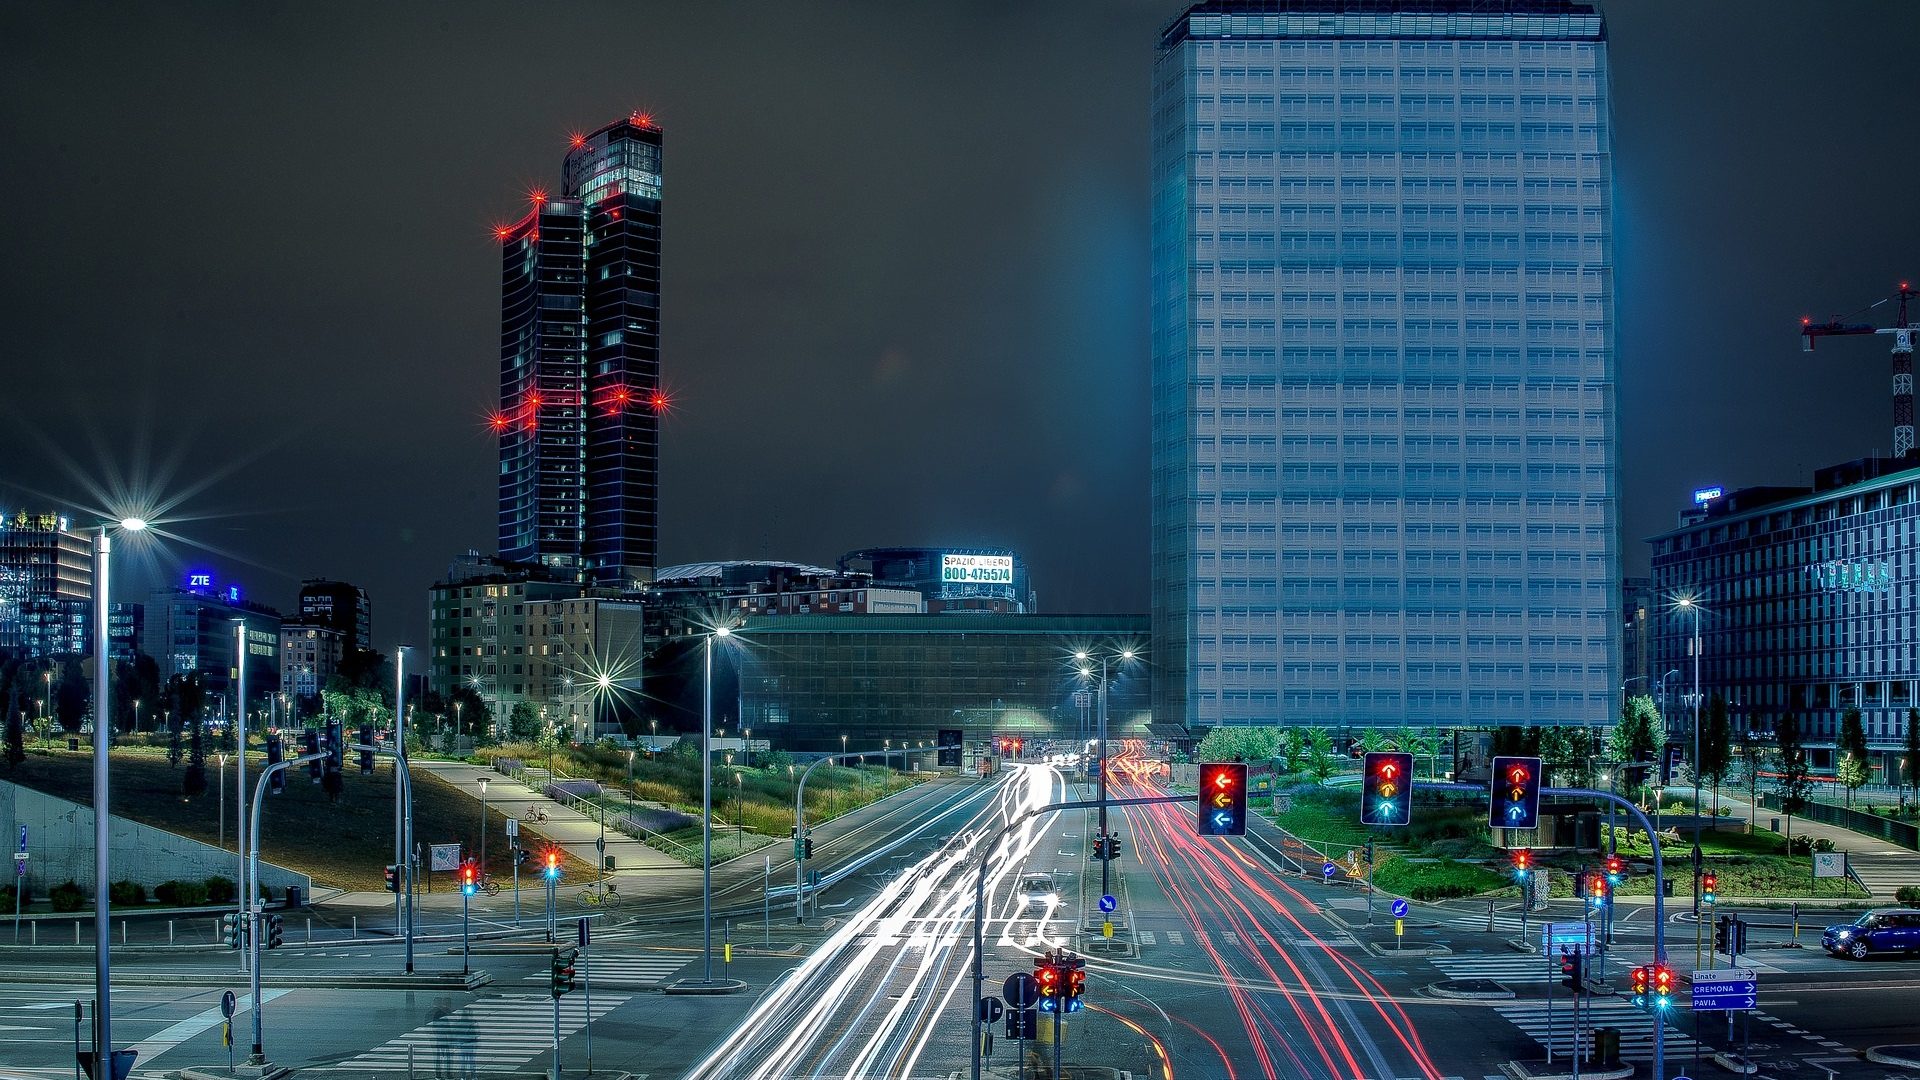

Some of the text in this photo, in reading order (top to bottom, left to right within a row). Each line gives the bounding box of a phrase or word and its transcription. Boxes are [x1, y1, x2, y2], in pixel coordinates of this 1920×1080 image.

[1696, 490, 1721, 501] FINECO
[944, 556, 1010, 567] SPAZIO LIBERO
[944, 567, 1011, 581] 800-475574
[190, 575, 210, 586] ZTE
[1694, 985, 1734, 993] CREMONA
